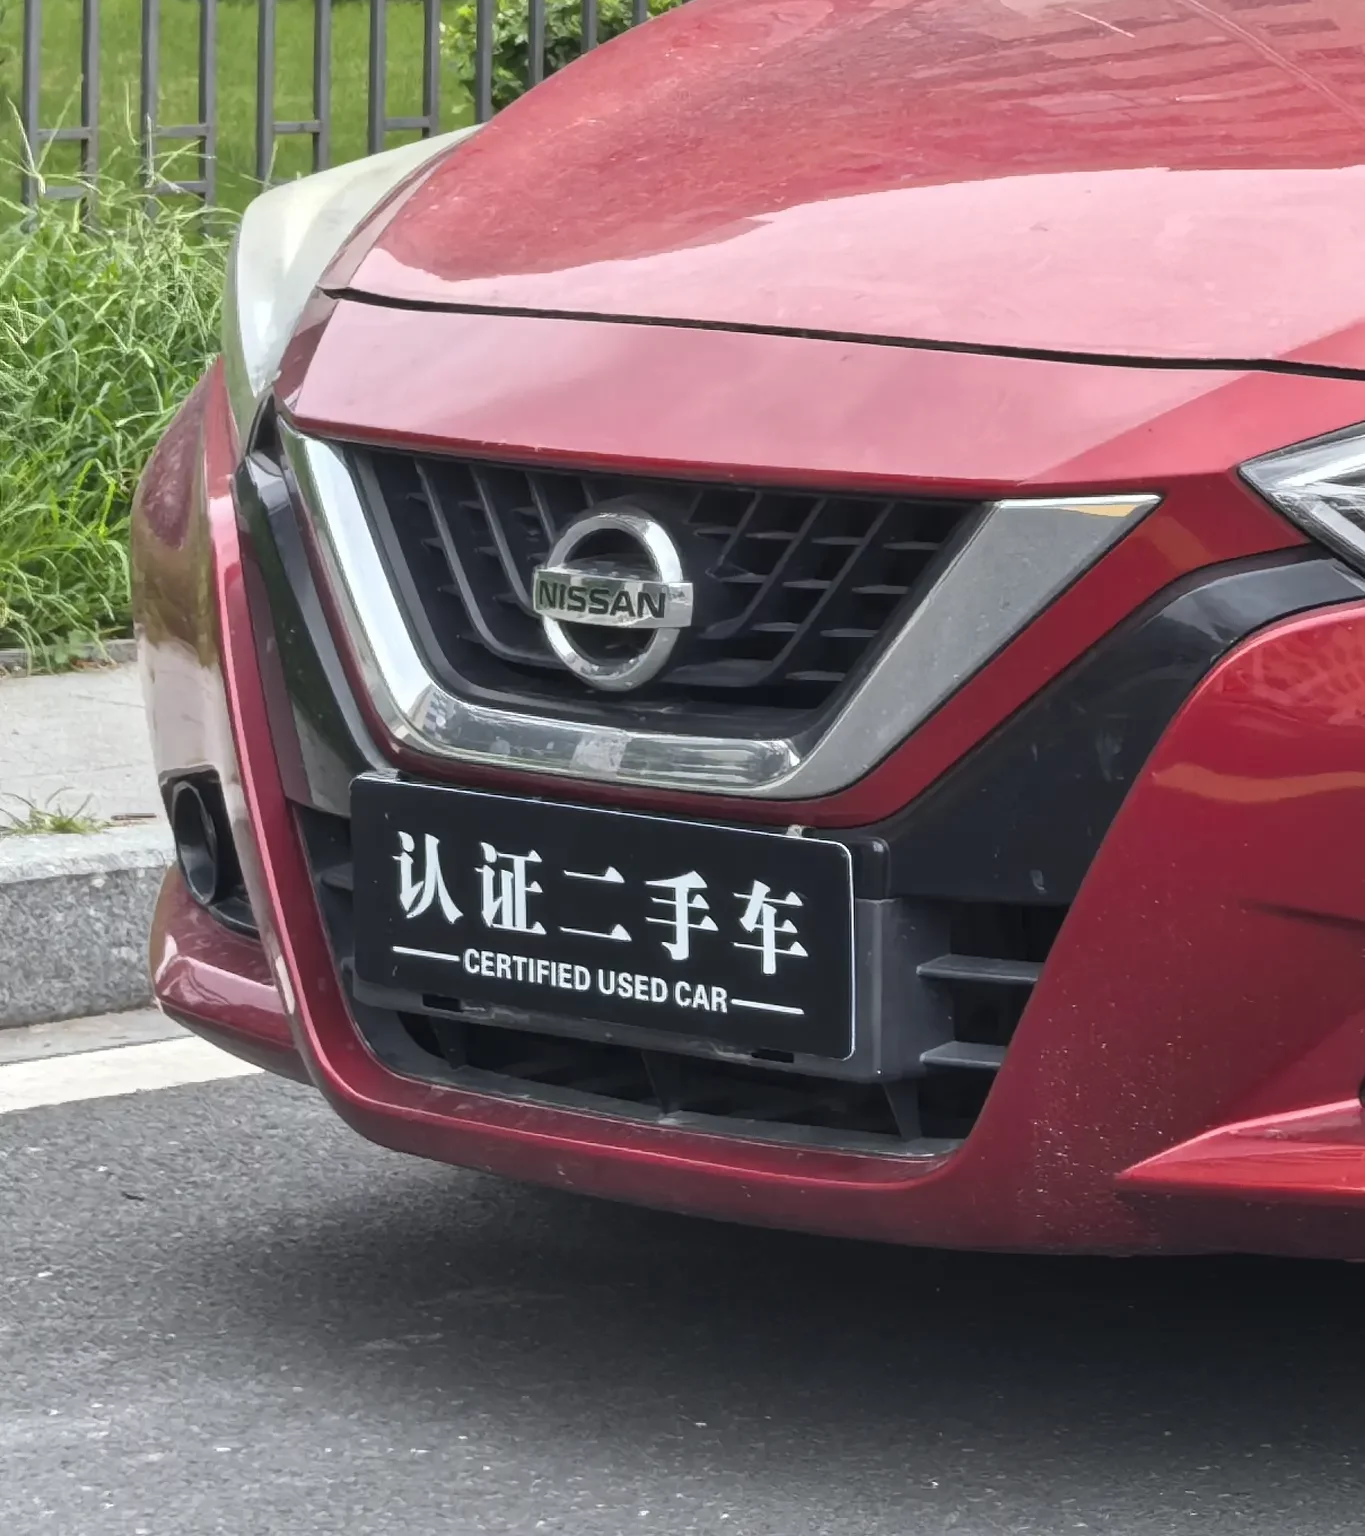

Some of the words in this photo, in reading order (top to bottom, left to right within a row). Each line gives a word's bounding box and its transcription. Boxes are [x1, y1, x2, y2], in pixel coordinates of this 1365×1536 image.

[539, 580, 666, 618] NISSAN
[392, 830, 809, 975] 认证二手车
[464, 949, 591, 991] CERTIFIED
[598, 969, 668, 1004] USED
[674, 981, 728, 1014] CAR
